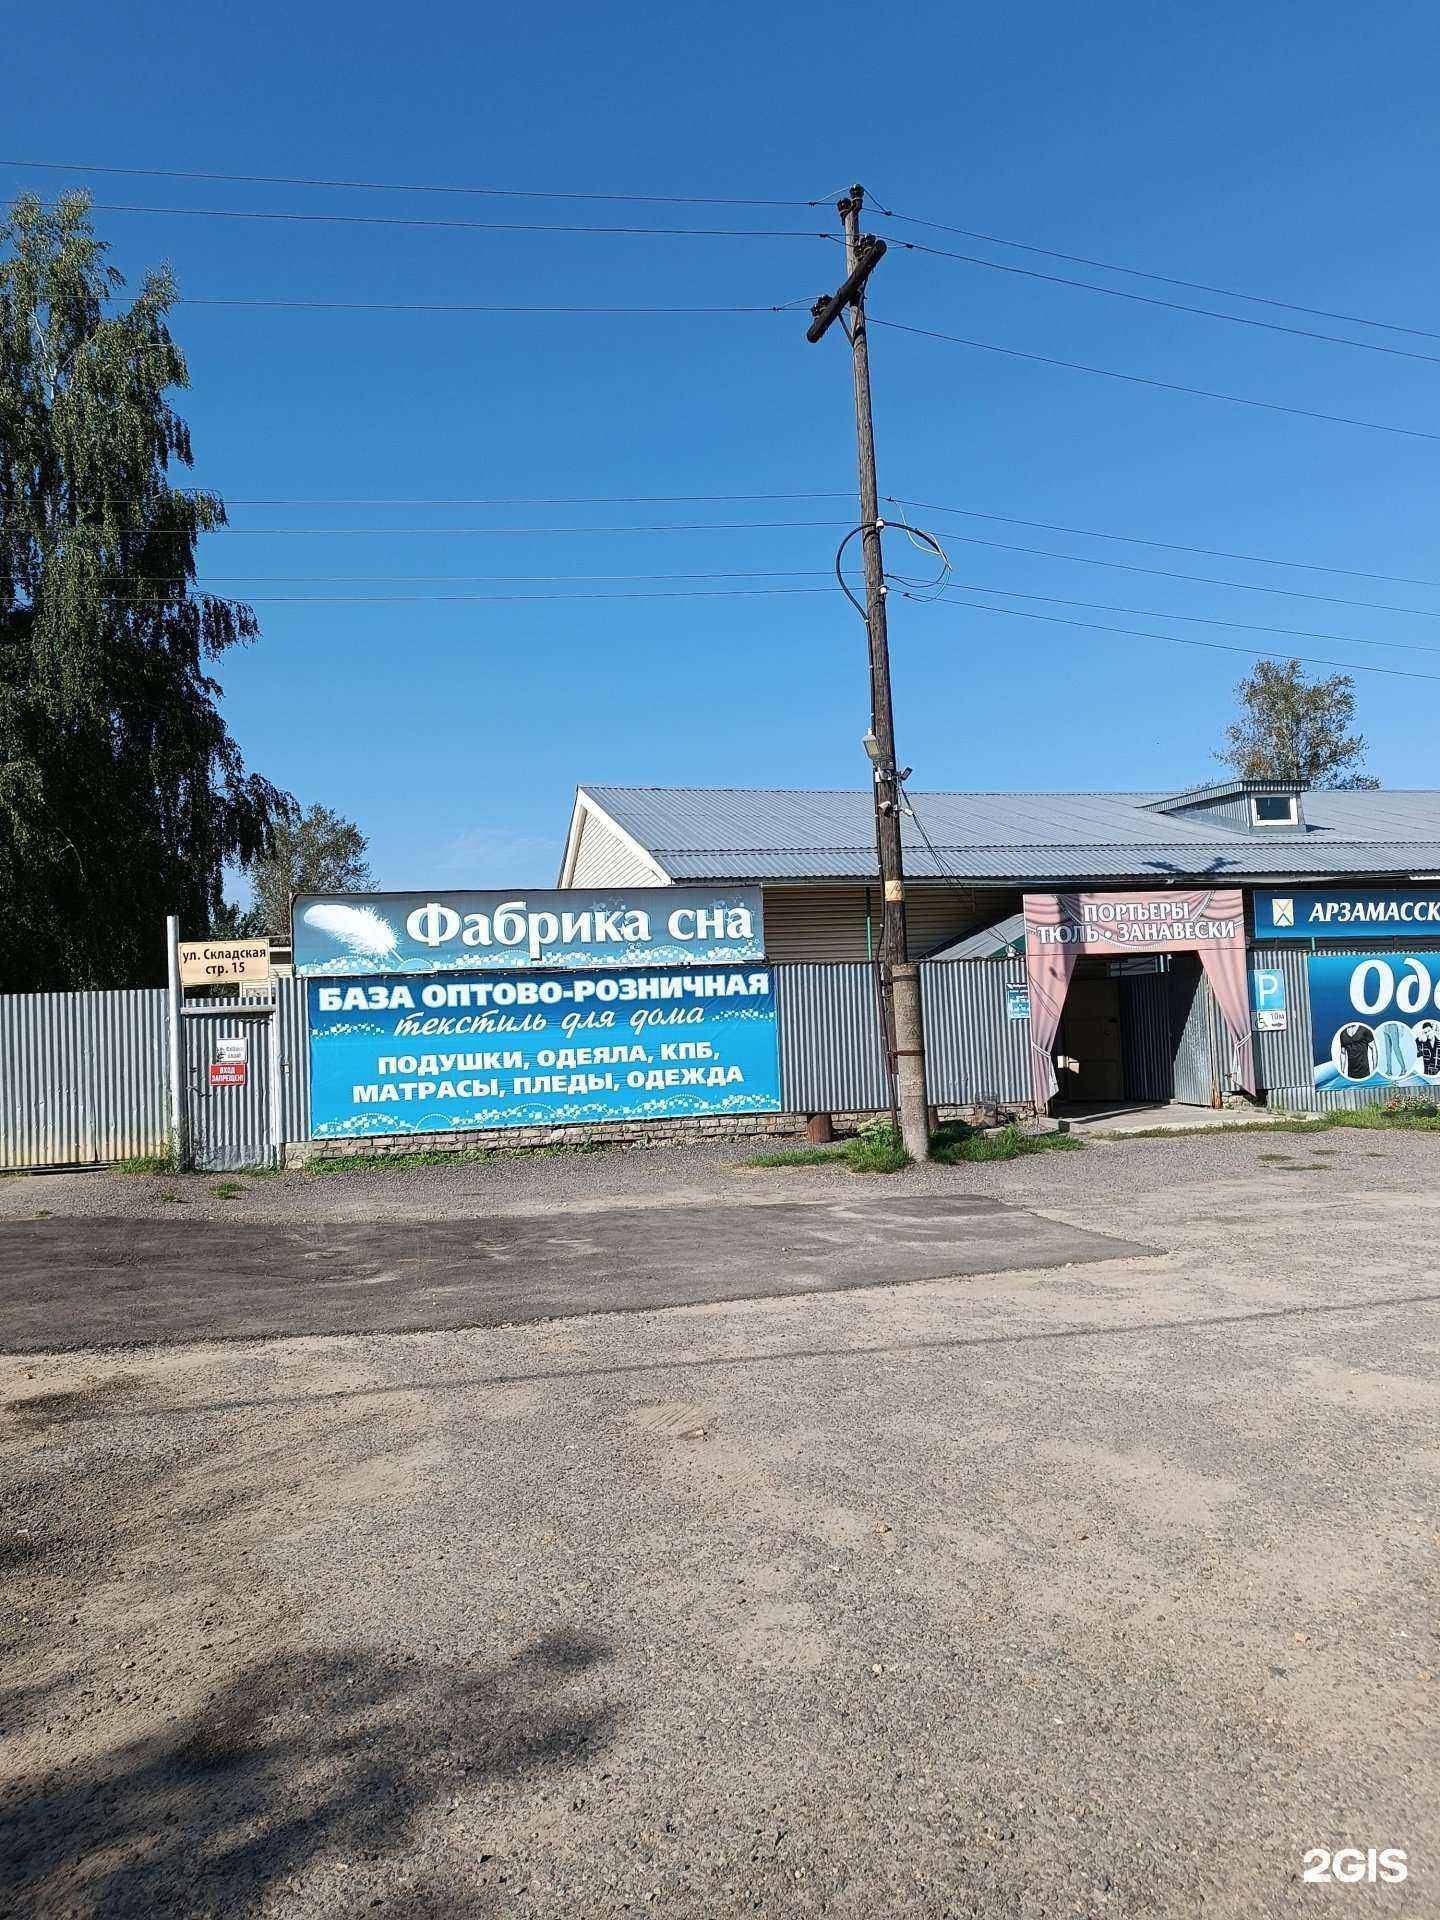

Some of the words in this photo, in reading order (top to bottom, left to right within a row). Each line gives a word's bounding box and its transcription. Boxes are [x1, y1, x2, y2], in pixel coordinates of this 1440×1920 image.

[1083, 902, 1190, 922] ПОРТЬЕРЫ
[406, 901, 652, 961] Фабрика
[668, 906, 754, 940] сна
[1037, 925, 1099, 944] ТЮЛЬ
[1117, 921, 1236, 942] ЗАНАВЕСКИ
[183, 951, 201, 964] ул.
[203, 948, 266, 960] Складская
[205, 965, 229, 976] стр.
[231, 961, 245, 973] 15
[318, 984, 416, 1012] БАЗА
[421, 972, 769, 1009] ОПТОВО-РОЗНИЧНАЯ
[393, 1009, 548, 1037] текстиль
[561, 1010, 616, 1039] для
[629, 1007, 705, 1036] дома
[378, 1050, 531, 1076] ПОДУШКИ,
[536, 1045, 654, 1070] ОДЕЯЛА,
[660, 1041, 720, 1061] КПБ,
[352, 1078, 506, 1104] МАТРАСЫ,
[512, 1072, 620, 1095] ПЛЕДЫ,
[626, 1065, 745, 1090] ОДЕЖДА
